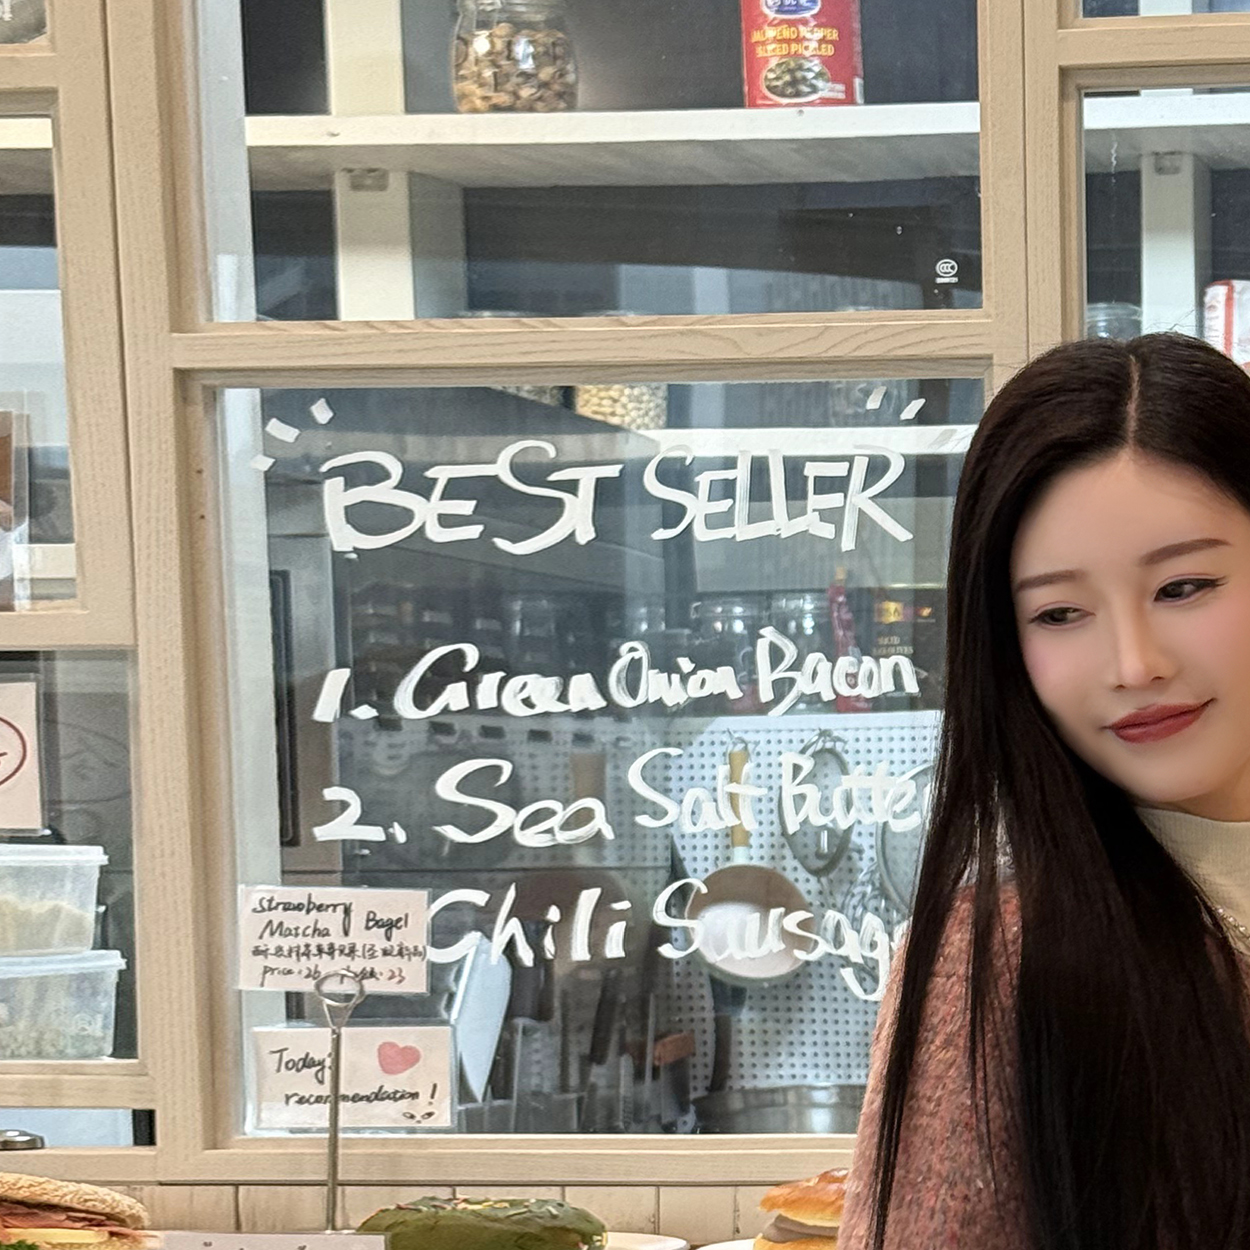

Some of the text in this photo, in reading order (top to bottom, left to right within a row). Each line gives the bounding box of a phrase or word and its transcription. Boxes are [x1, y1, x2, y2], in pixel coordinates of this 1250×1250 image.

[319, 439, 914, 556] BEST SELLER
[312, 626, 920, 723] 1. Green Onion Bacon
[313, 786, 407, 844] 2.
[433, 759, 615, 847] Sea
[628, 747, 768, 833] Salt
[252, 894, 352, 936] Strawberry
[258, 919, 331, 940] Matcha
[364, 911, 409, 941] Bagel
[427, 878, 910, 1000] Chili Sausag
[270, 1047, 333, 1085] Today'
